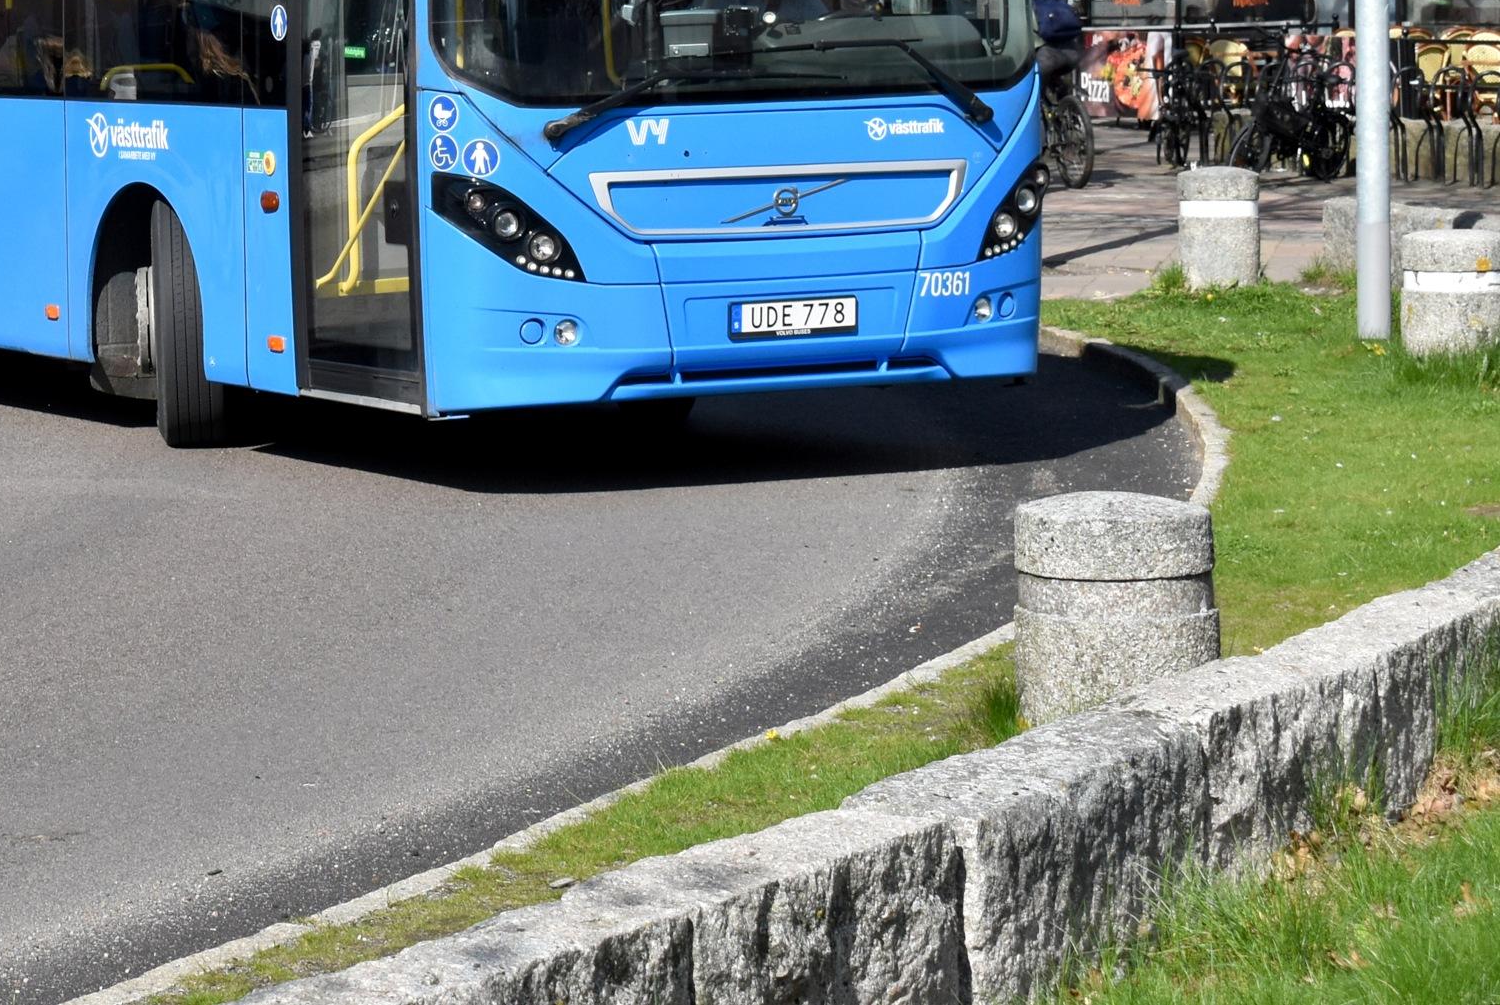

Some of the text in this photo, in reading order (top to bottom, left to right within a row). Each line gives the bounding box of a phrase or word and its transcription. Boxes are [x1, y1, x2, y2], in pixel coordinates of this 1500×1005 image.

[1080, 72, 1110, 103] Pizza
[110, 118, 169, 150] västtrafik
[888, 118, 945, 135] västtrafik
[919, 271, 970, 297] 70361
[751, 301, 845, 329] UDE 778
[775, 329, 793, 337] VOLVO
